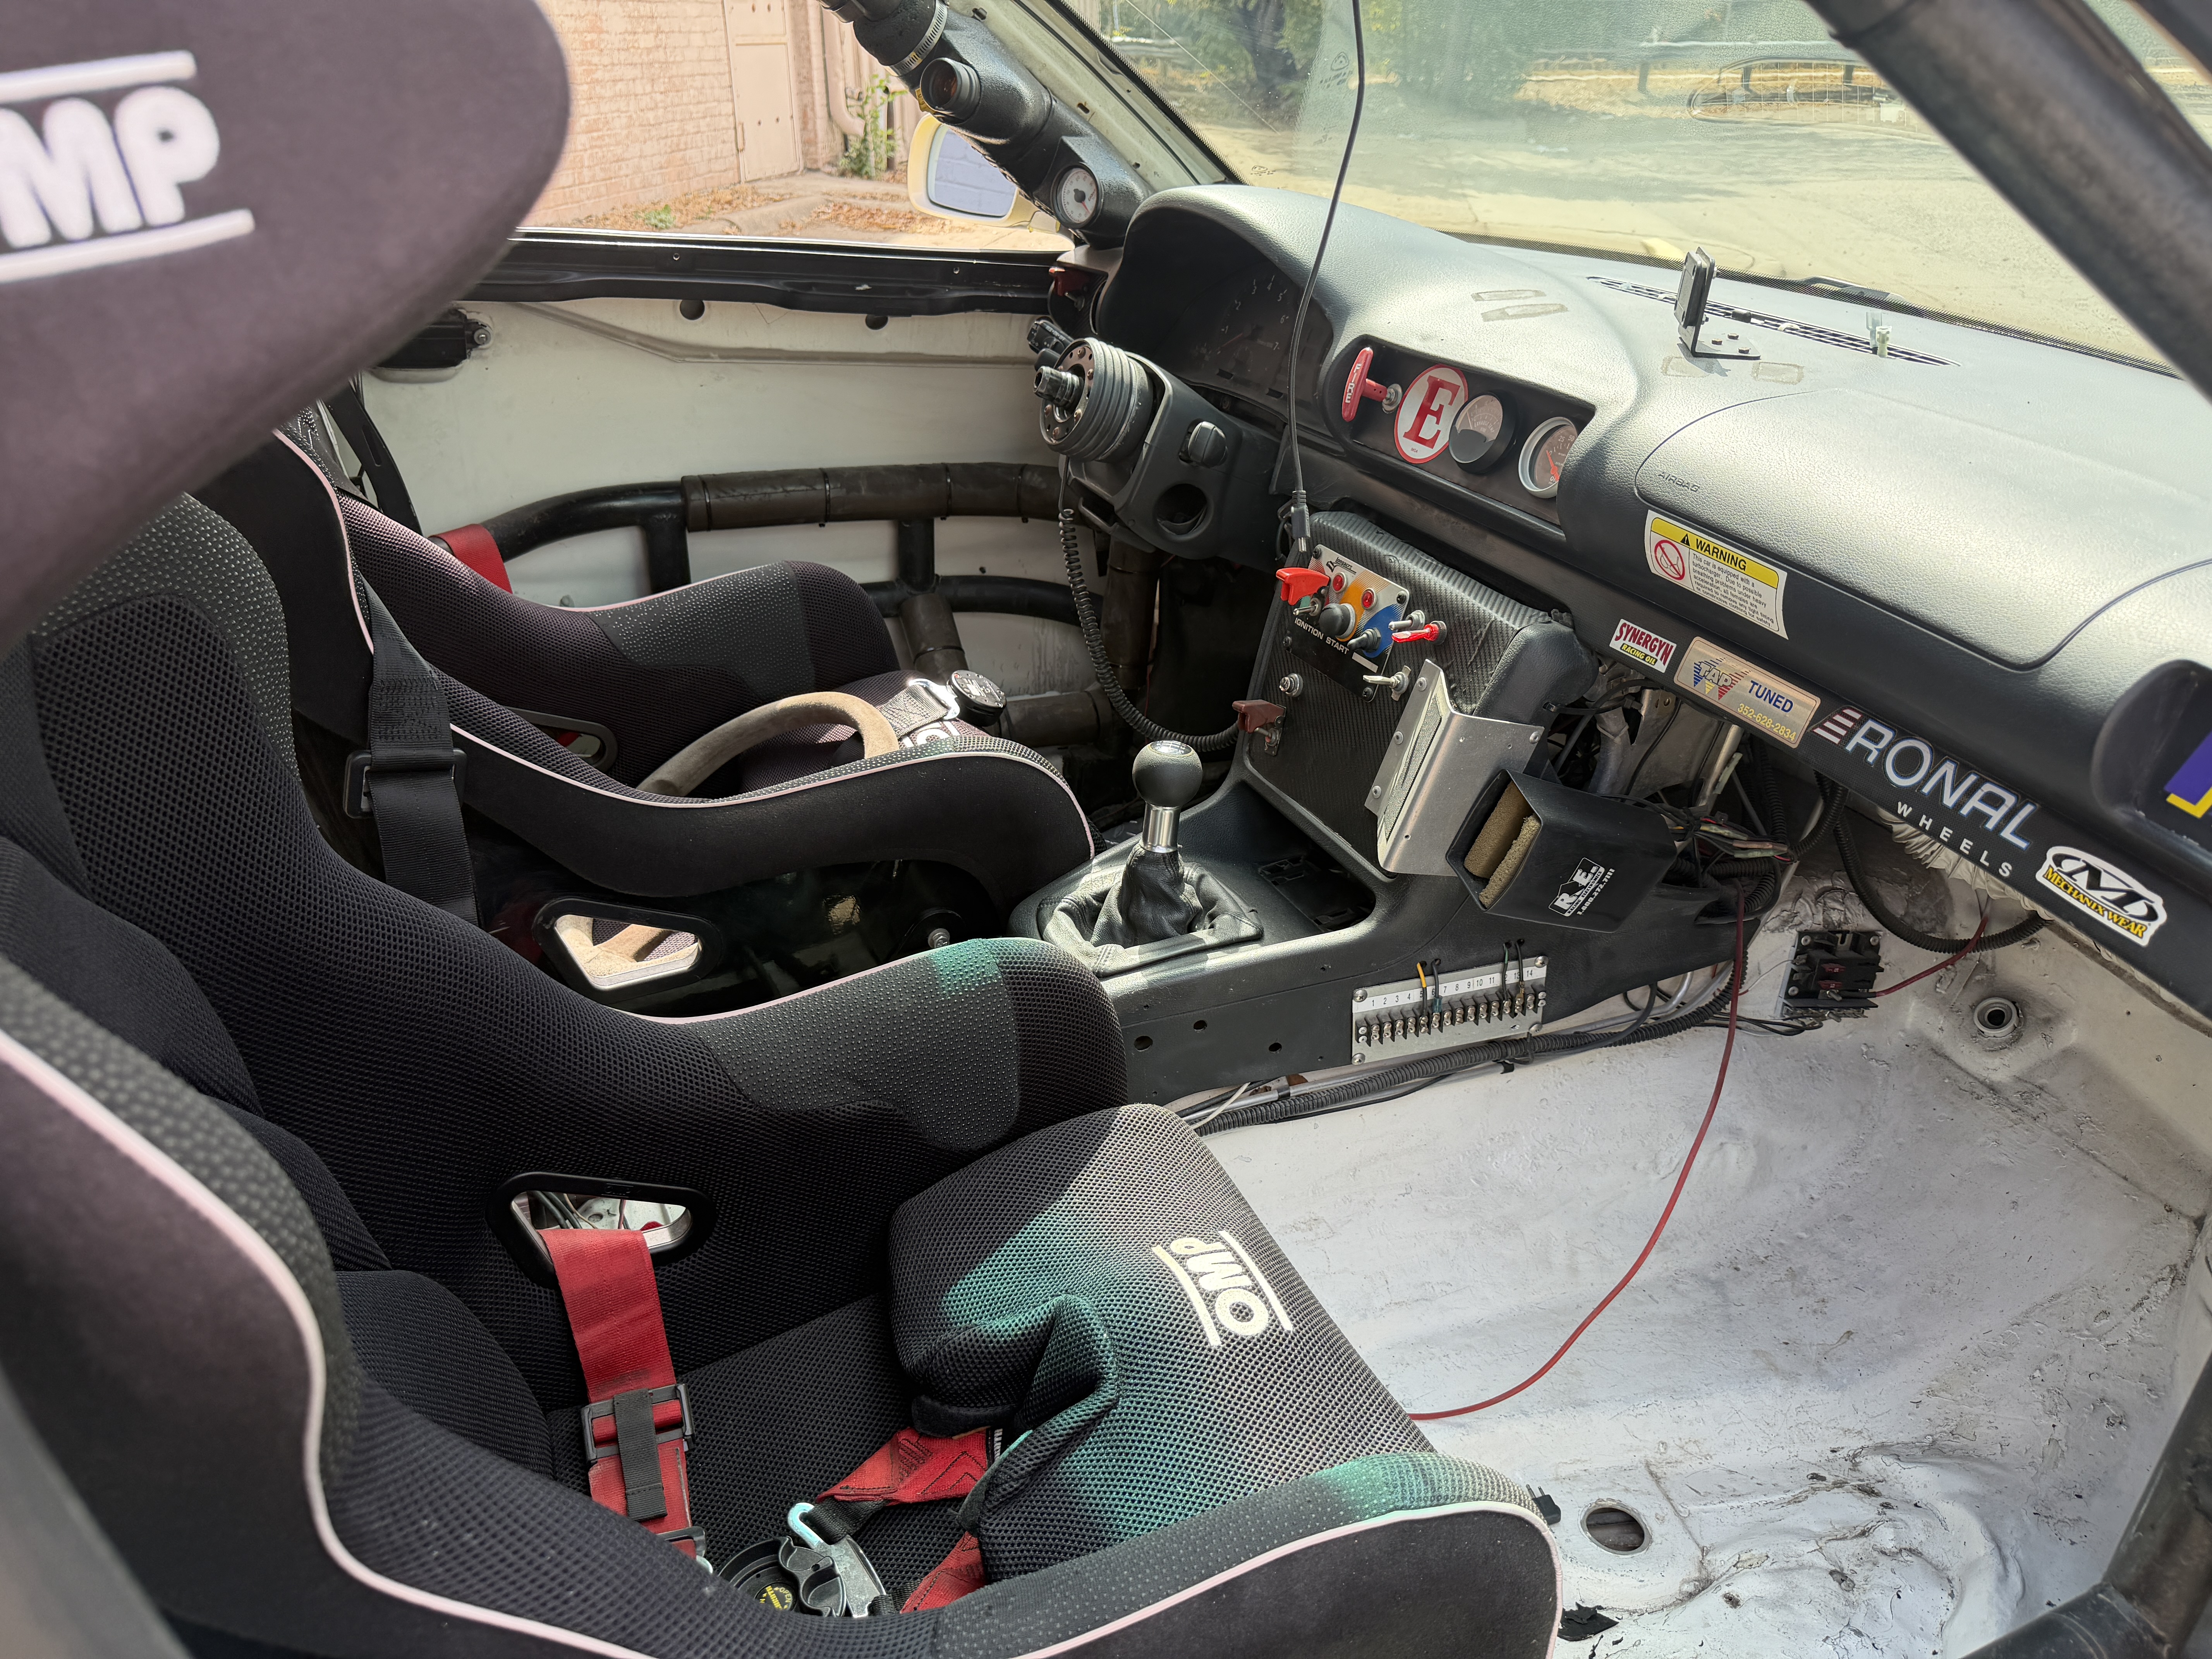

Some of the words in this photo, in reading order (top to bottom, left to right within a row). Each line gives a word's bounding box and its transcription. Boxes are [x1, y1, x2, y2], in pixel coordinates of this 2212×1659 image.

[1345, 363, 1362, 403] FIRE
[1403, 375, 1461, 450] E
[1657, 471, 1700, 492] AIRBAG
[1335, 556, 1353, 569] Longacre
[1693, 553, 1702, 562] This
[1717, 567, 1739, 580] equipped
[1741, 577, 1750, 585] with
[1696, 538, 1747, 571] WARNING
[1693, 560, 1722, 579] turbocharger.
[1726, 576, 1735, 585] Due
[1743, 585, 1762, 598] possible
[1693, 567, 1714, 582] breathing
[1715, 579, 1736, 592] problems
[1738, 589, 1751, 599] under
[1752, 596, 1766, 608] heavy
[1295, 617, 1324, 640] IGNITION
[1326, 636, 1349, 654] START
[1614, 622, 1674, 666] SYNERGYN
[1621, 644, 1645, 659] RACING
[1645, 656, 1656, 665] OIL
[1698, 661, 1733, 687] TAP
[1748, 680, 1794, 713] TUNED
[1737, 703, 1797, 741] 352-628-2834
[1844, 718, 2038, 850] RONAL
[1897, 801, 2012, 878] WHEELS
[1568, 899, 1582, 914] RACING
[2044, 866, 2106, 915] MECHANIX
[2107, 911, 2148, 938] WEAR
[1170, 1237, 1269, 1335] OMP
[779, 1587, 792, 1602] OPEN
